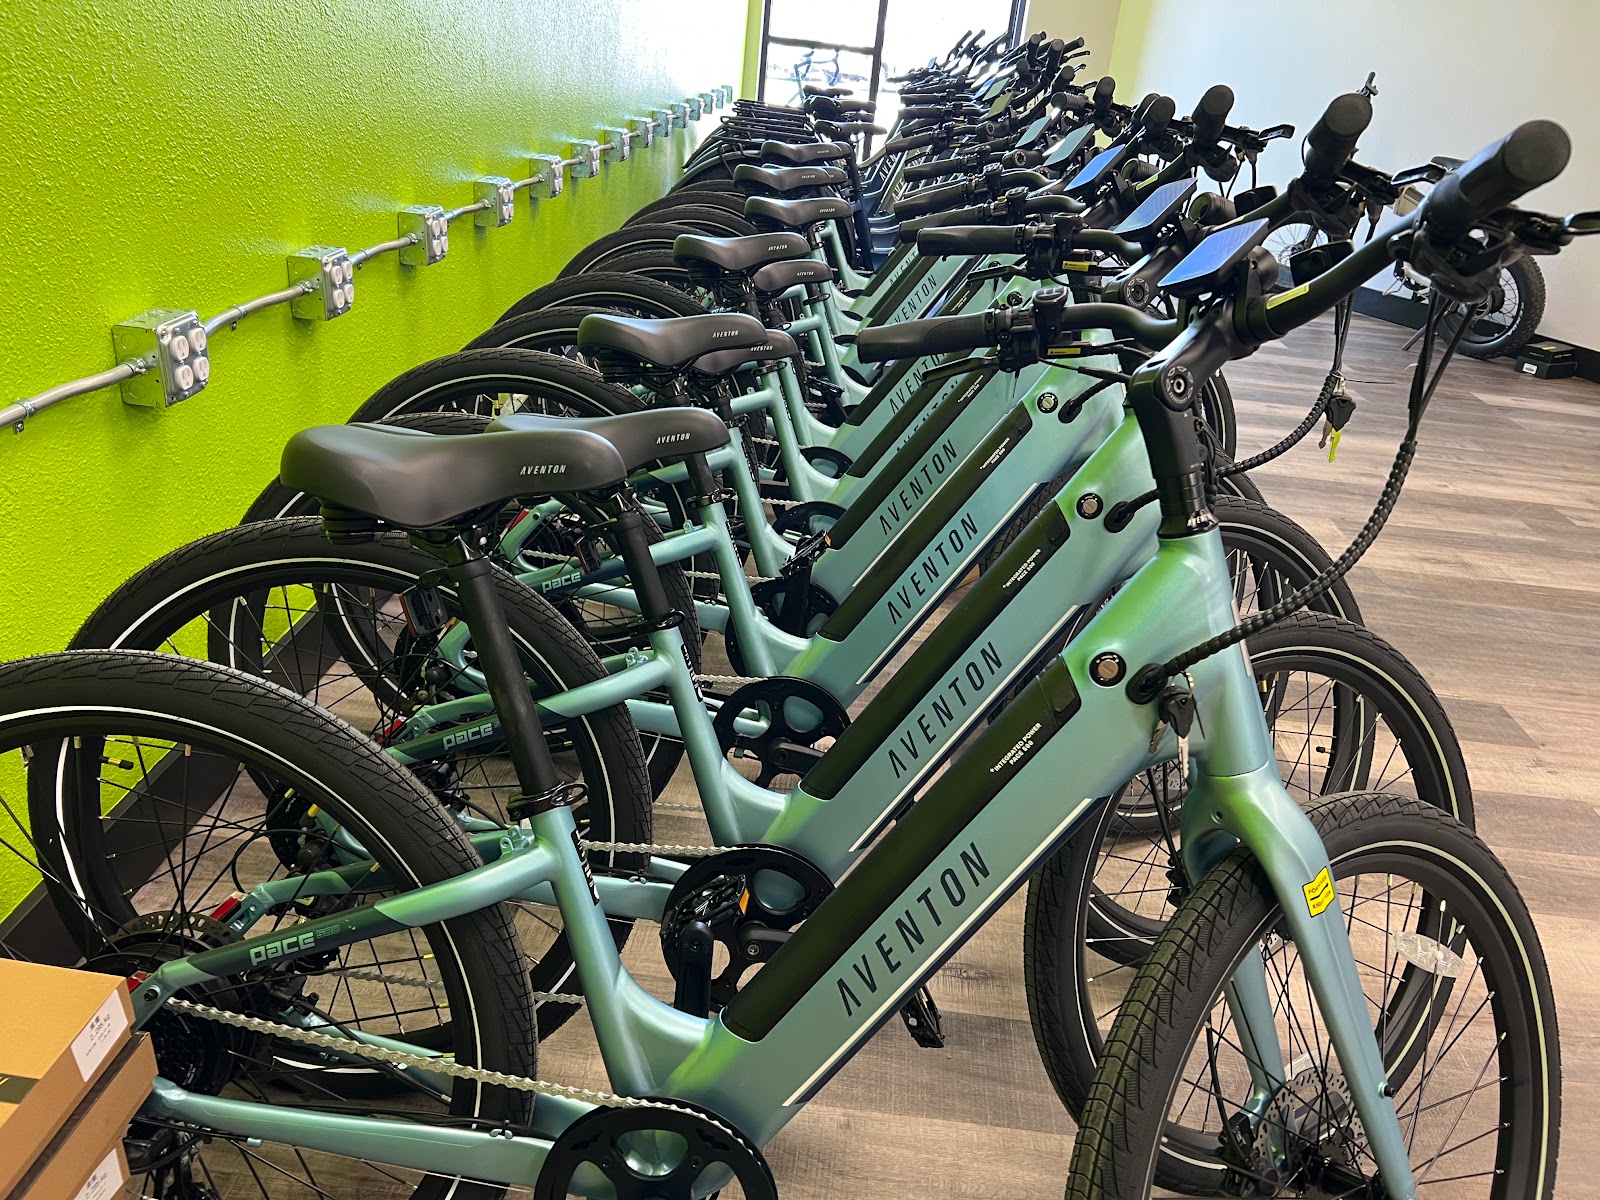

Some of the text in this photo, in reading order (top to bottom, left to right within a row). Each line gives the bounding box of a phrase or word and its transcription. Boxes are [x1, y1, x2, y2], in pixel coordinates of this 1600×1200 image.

[894, 274, 937, 325] VENTON
[712, 330, 739, 338] AVENTON
[750, 345, 773, 353] AVENTON
[889, 353, 945, 415] AVENTO
[656, 432, 691, 444] AVENTON
[520, 464, 567, 476] AVENTON
[879, 439, 957, 535] AVENTON
[887, 512, 978, 625] AVENTON
[1027, 549, 1041, 564] POWER
[888, 641, 1003, 779] AVENTON
[994, 722, 1042, 772] INTEGRATED POWER
[1009, 740, 1034, 765] PACE 500
[316, 924, 340, 939] 500
[836, 841, 990, 1018] AVENTON
